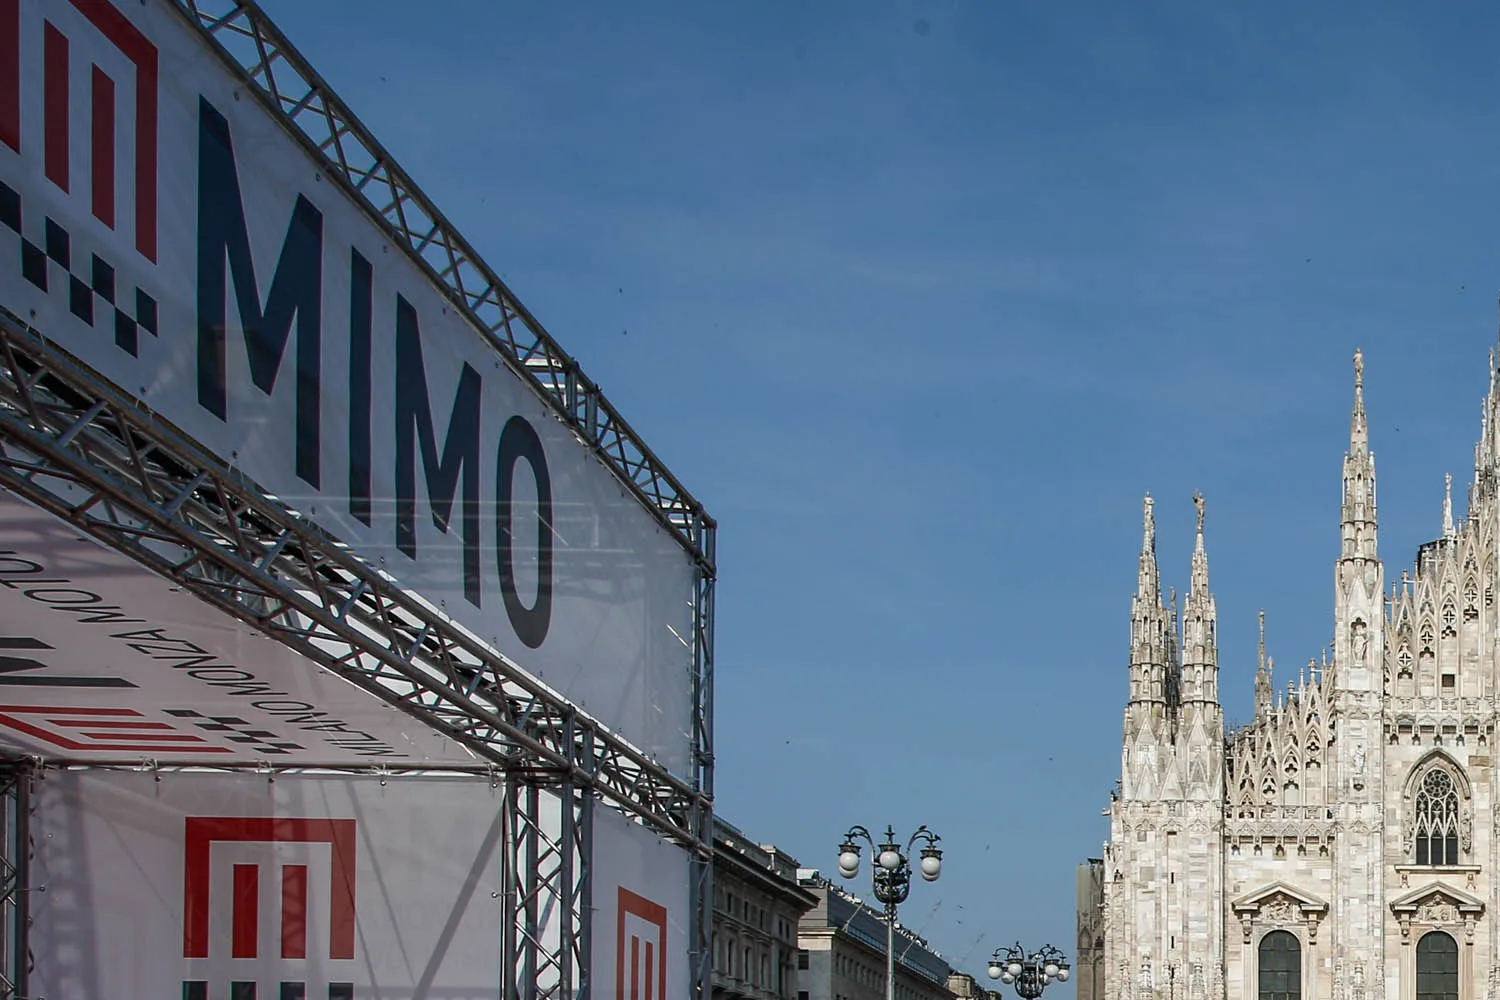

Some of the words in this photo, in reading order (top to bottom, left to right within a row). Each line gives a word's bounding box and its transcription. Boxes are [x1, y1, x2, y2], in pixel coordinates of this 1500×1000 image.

[197, 94, 553, 650] MIMO
[0, 551, 146, 623] MOTO
[109, 628, 289, 696] MONZA
[251, 700, 409, 758] MILANO
